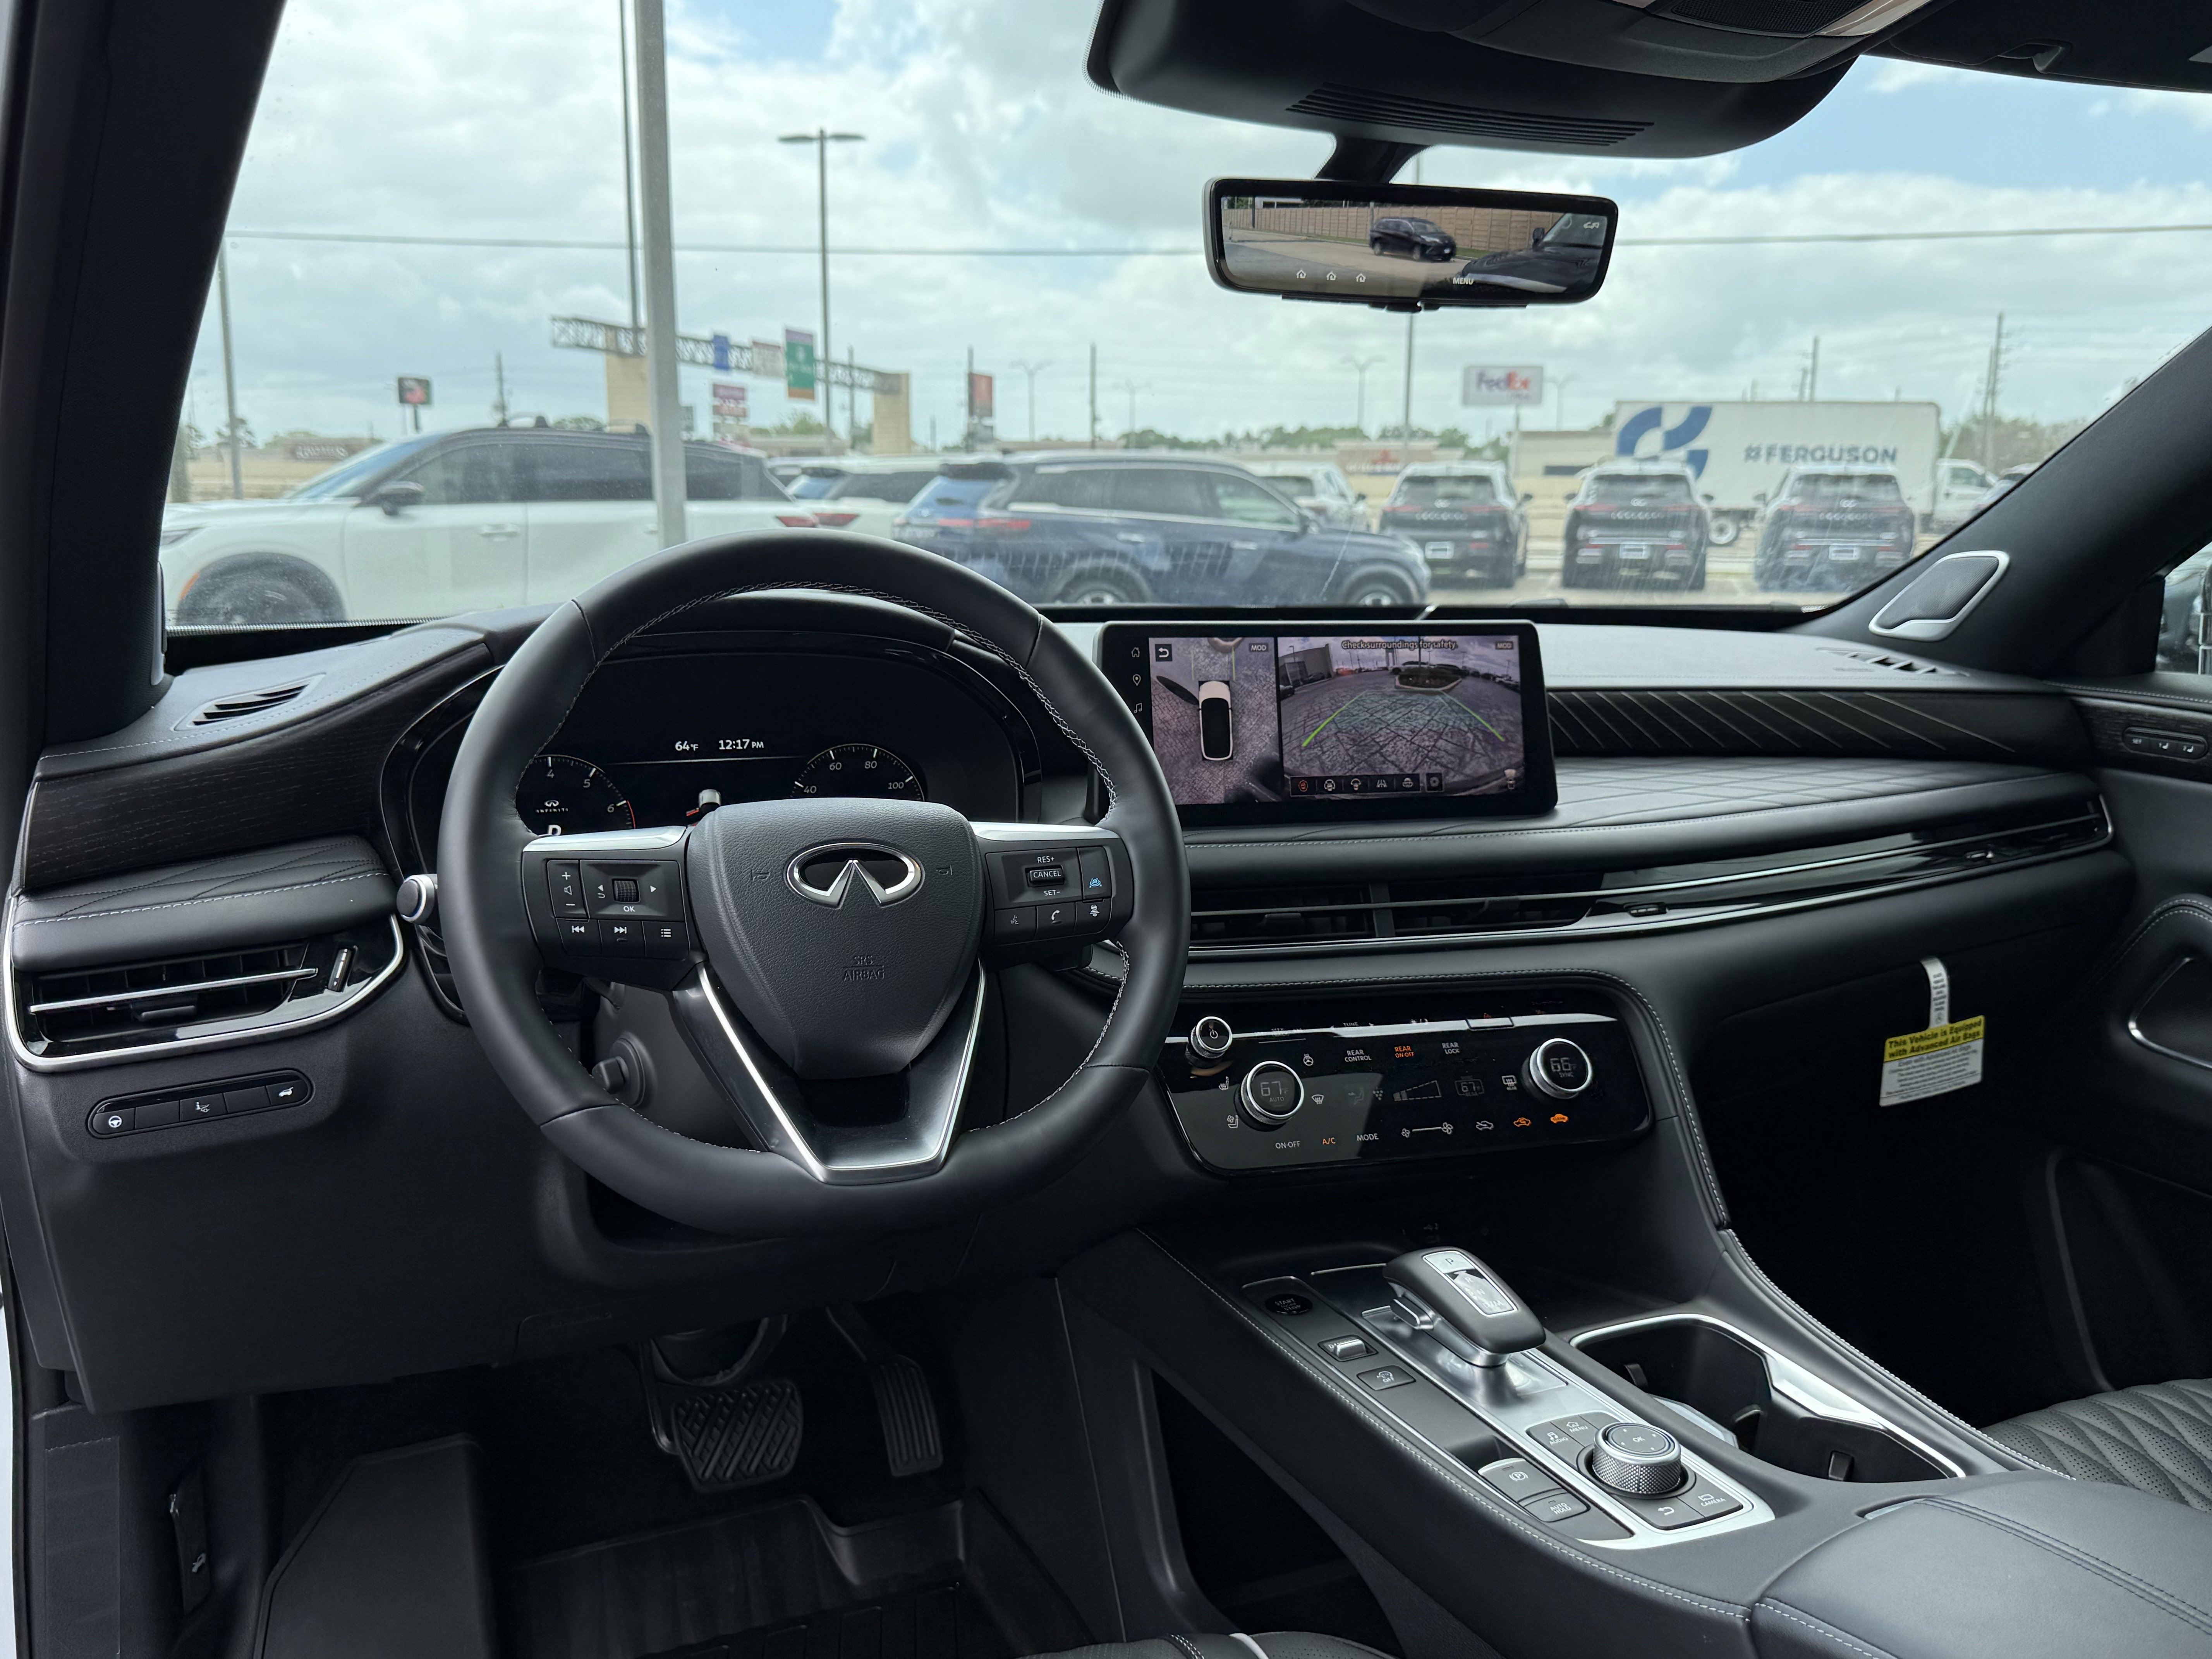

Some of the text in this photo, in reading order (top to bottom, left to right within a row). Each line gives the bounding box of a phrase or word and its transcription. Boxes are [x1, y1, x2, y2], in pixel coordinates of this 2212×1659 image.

[1476, 371, 1530, 391] FedEx
[1342, 641, 1365, 649] Check
[1367, 641, 1418, 651] surroundings
[1420, 640, 1431, 649] for
[718, 739, 750, 750] 12:17
[830, 762, 842, 771] 60
[864, 761, 877, 769] 80
[547, 769, 554, 778] 4
[583, 779, 591, 788] 5
[804, 785, 817, 793] 40
[607, 804, 615, 813] 6
[548, 824, 562, 836] D
[854, 955, 873, 965] SRS
[844, 969, 884, 981] AIRBAG
[1889, 1039, 1906, 1048] This
[1909, 1032, 1938, 1043] Vehicle
[1949, 1018, 1982, 1034] Equipped
[1889, 1048, 1907, 1058] with
[1909, 1038, 1949, 1053] Advanced
[1963, 1030, 1980, 1040] Bags
[1345, 1054, 1372, 1063] CONTROL
[1357, 1133, 1379, 1141] MODE
[1549, 1437, 1568, 1445] AUDIO
[1701, 1498, 1726, 1506] CAMERA
[1550, 1503, 1567, 1511] AUTO
[1554, 1506, 1571, 1515] HOLD
